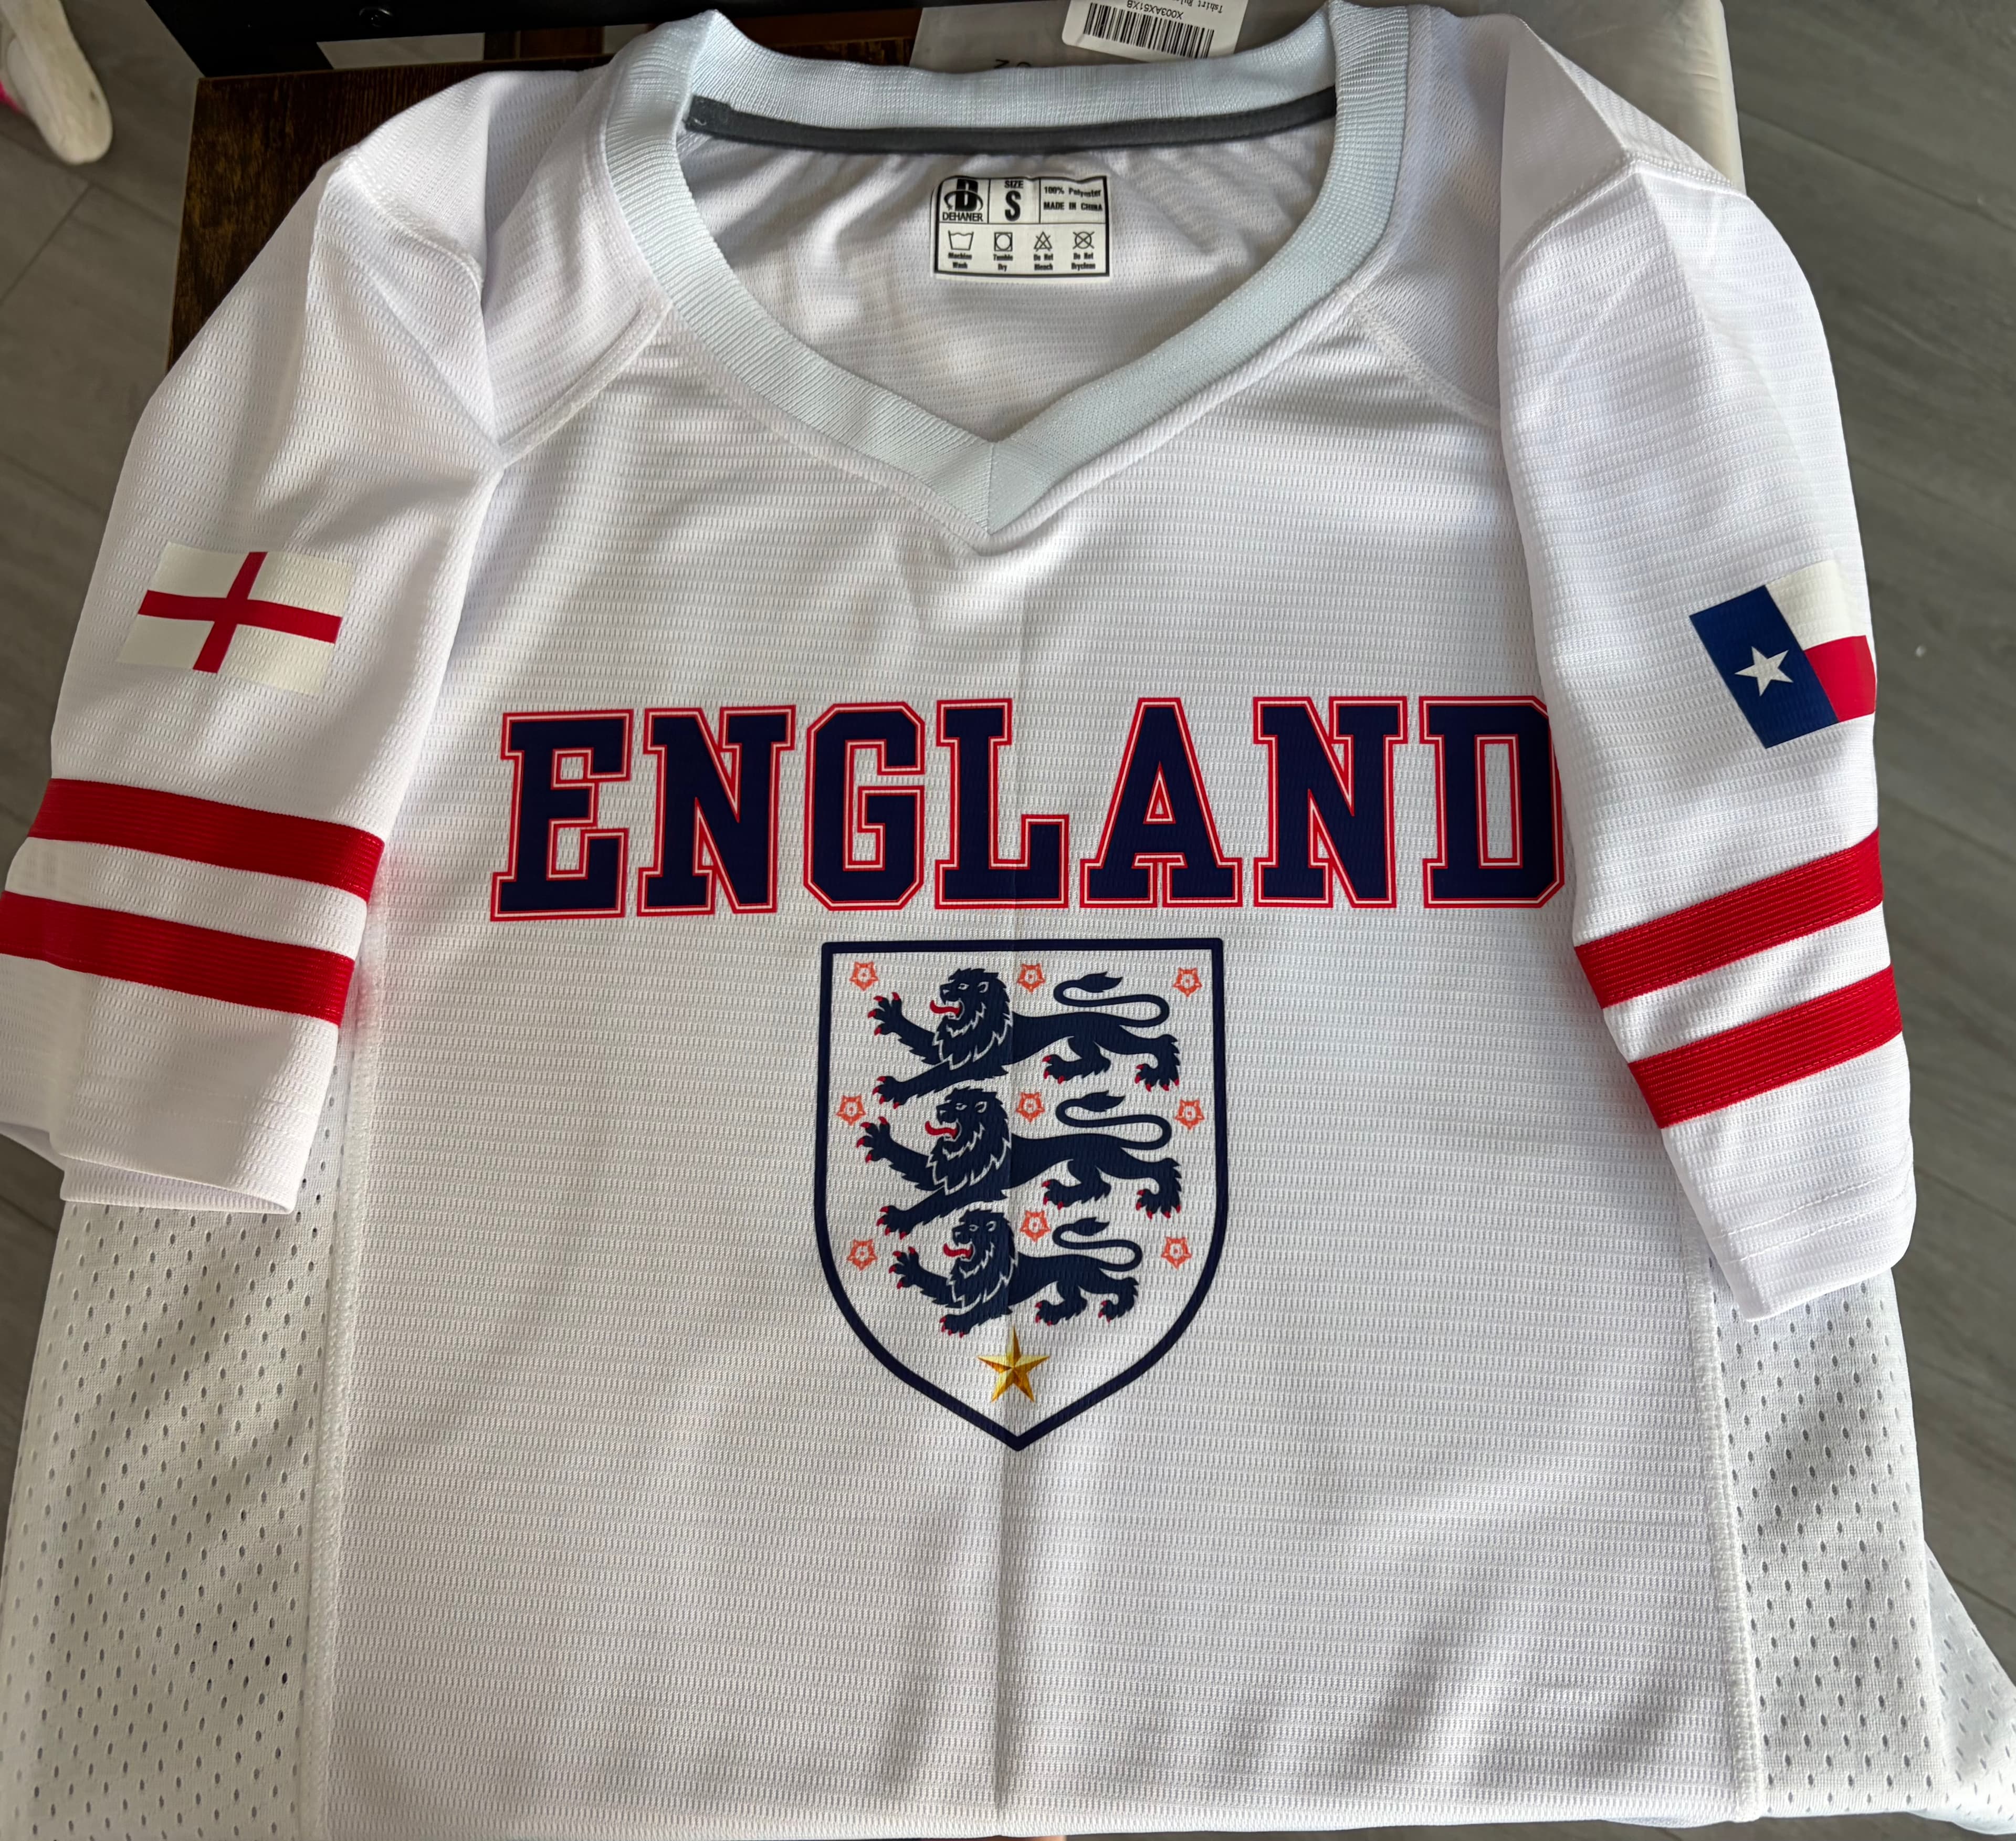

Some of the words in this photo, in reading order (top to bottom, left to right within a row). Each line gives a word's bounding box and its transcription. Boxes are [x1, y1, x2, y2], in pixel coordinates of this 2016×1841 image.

[1127, 0, 1183, 19] X003AX51XB
[1198, 1, 1223, 14] Tshirt
[1004, 180, 1023, 189] SIZE
[1044, 186, 1065, 195] 100%
[1068, 187, 1101, 197] Polyester
[1004, 190, 1021, 222] S
[1043, 202, 1065, 210] MADE
[1069, 202, 1076, 210] IN
[1081, 203, 1103, 211] CHINA
[942, 212, 983, 222] DEHANER
[998, 263, 1007, 272] Dry
[490, 695, 1565, 922] ENGLAND
